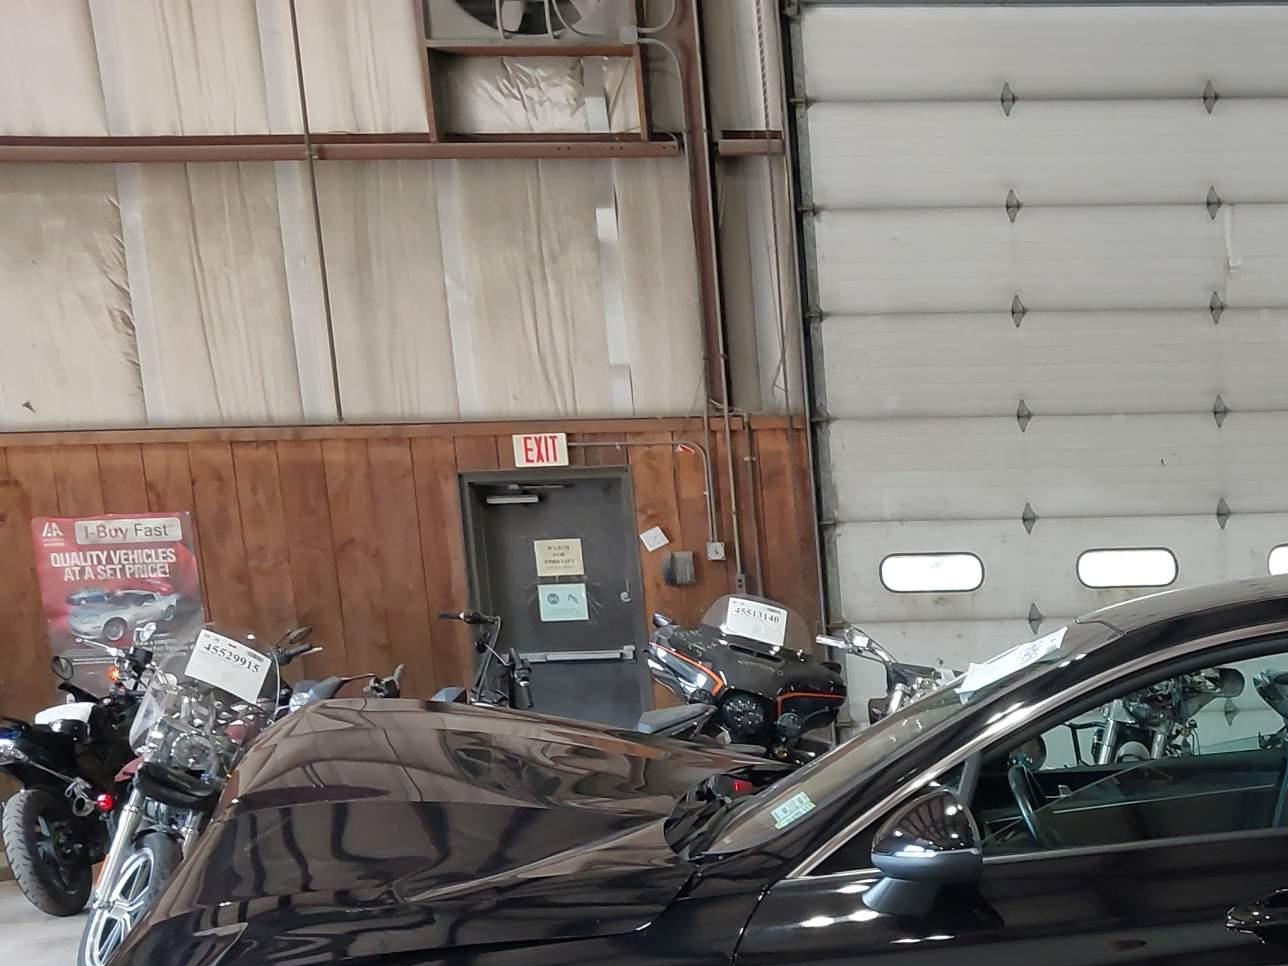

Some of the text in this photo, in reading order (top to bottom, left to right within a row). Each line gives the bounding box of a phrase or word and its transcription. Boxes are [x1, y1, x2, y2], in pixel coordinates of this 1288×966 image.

[523, 435, 559, 464] EXIT
[84, 523, 169, 541] I-Buy Fast
[51, 548, 177, 568] QUALITY VEHICLES
[64, 563, 169, 582] AT A SET PRICE!
[734, 607, 780, 623] 45513140
[203, 643, 261, 674] 45529915
